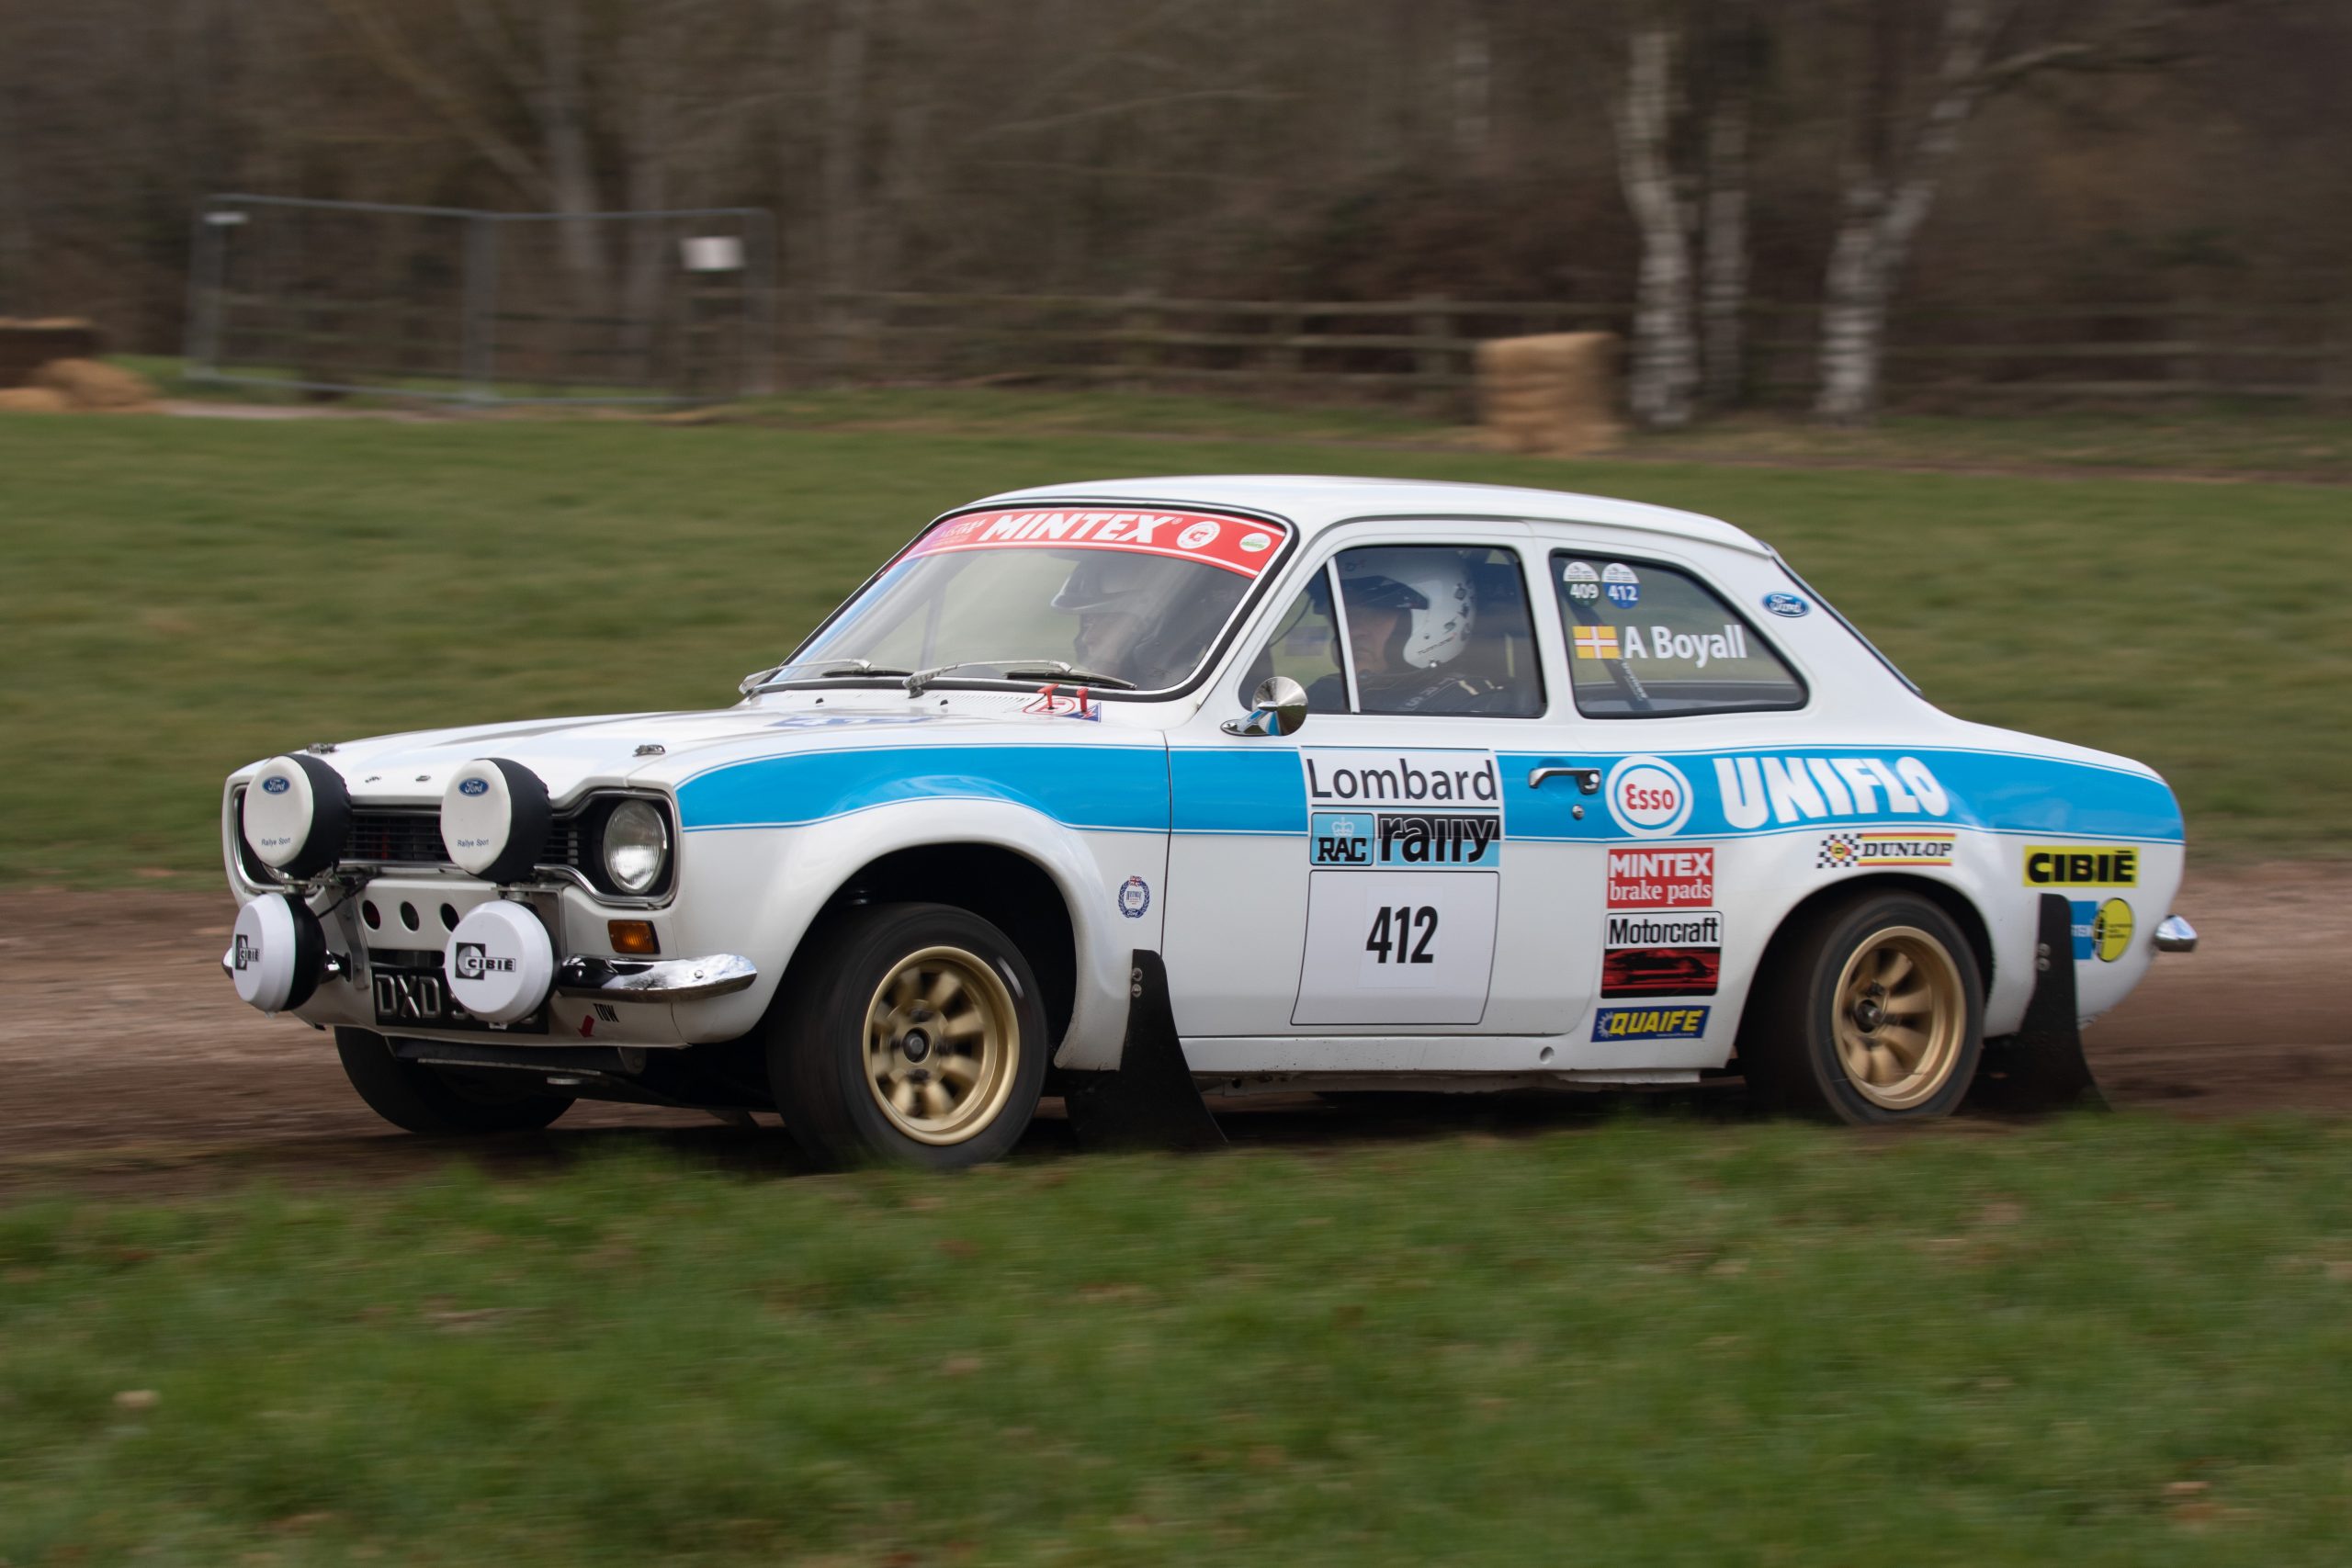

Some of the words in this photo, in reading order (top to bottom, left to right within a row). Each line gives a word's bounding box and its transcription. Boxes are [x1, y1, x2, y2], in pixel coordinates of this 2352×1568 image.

[978, 513, 1173, 545] MINTEX
[1569, 583, 1600, 600] 409
[1608, 584, 1638, 602] 412
[1770, 594, 1803, 614] Ford
[1624, 626, 1647, 660] A
[1651, 624, 1747, 669] Boyall
[462, 780, 485, 795] Ford
[1306, 758, 1497, 802] Lombard
[1712, 755, 1950, 830] UNIFLO
[1317, 837, 1366, 863] RAC
[1380, 817, 1498, 863] rally
[1861, 841, 1953, 858] DUNLOP
[1609, 852, 1713, 878] MINTEX
[1609, 880, 1663, 901] brake
[1667, 878, 1713, 905] pads
[1365, 905, 1439, 964] 412
[1609, 917, 1718, 945] Motorcraft
[375, 974, 442, 1020] DXD
[593, 1002, 620, 1023] TOW
[1609, 1009, 1705, 1036] QUAIFE
